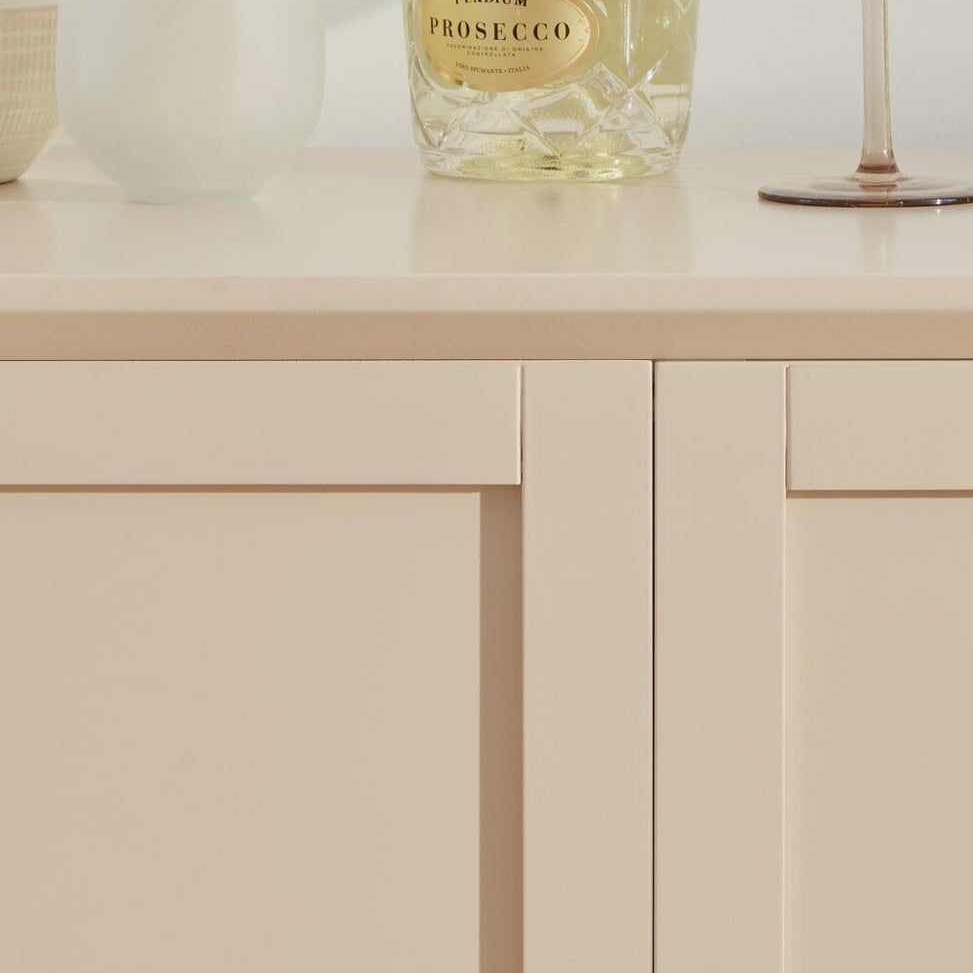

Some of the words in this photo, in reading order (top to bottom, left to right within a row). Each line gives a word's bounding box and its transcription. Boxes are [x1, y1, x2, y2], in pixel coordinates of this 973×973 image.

[430, 16, 570, 41] PROSECCO
[455, 61, 469, 71] VINO
[470, 65, 502, 74] SPUMANTE
[508, 65, 530, 74] ITALIA
